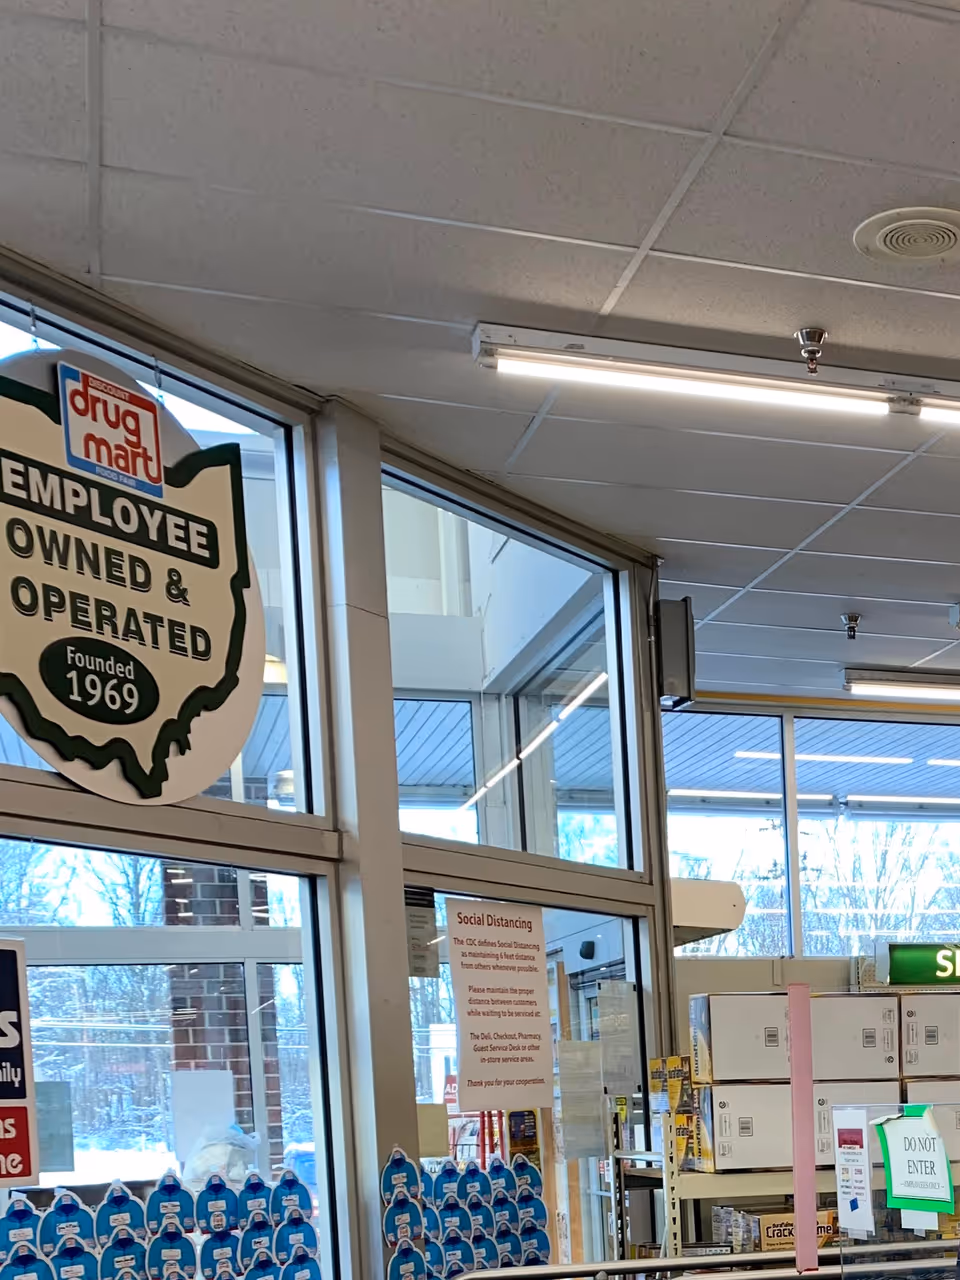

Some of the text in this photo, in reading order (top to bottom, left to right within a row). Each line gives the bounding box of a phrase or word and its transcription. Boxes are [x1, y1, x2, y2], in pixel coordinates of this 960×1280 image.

[89, 377, 130, 399] DISCOUNT
[70, 373, 141, 449] drug
[83, 432, 162, 484] mart
[1, 456, 211, 558] EMPLOYEE
[6, 517, 190, 605] OWNED &
[10, 575, 211, 662] OPERATED
[66, 645, 135, 680] Founded
[66, 669, 139, 714] 1969
[457, 912, 532, 932] Social Distancing
[453, 937, 540, 951] The Social Distancing
[468, 951, 535, 961] maintaining feet distance
[474, 962, 491, 970] others
[468, 985, 485, 993] Please
[486, 986, 509, 994] maintain
[519, 988, 534, 996] proper
[468, 997, 490, 1005] distance
[482, 1010, 501, 1018] waiting
[470, 1032, 479, 1040] The
[473, 1044, 489, 1052] Guest
[903, 1136, 937, 1152] DO NOT
[907, 1159, 936, 1176] ENTER
